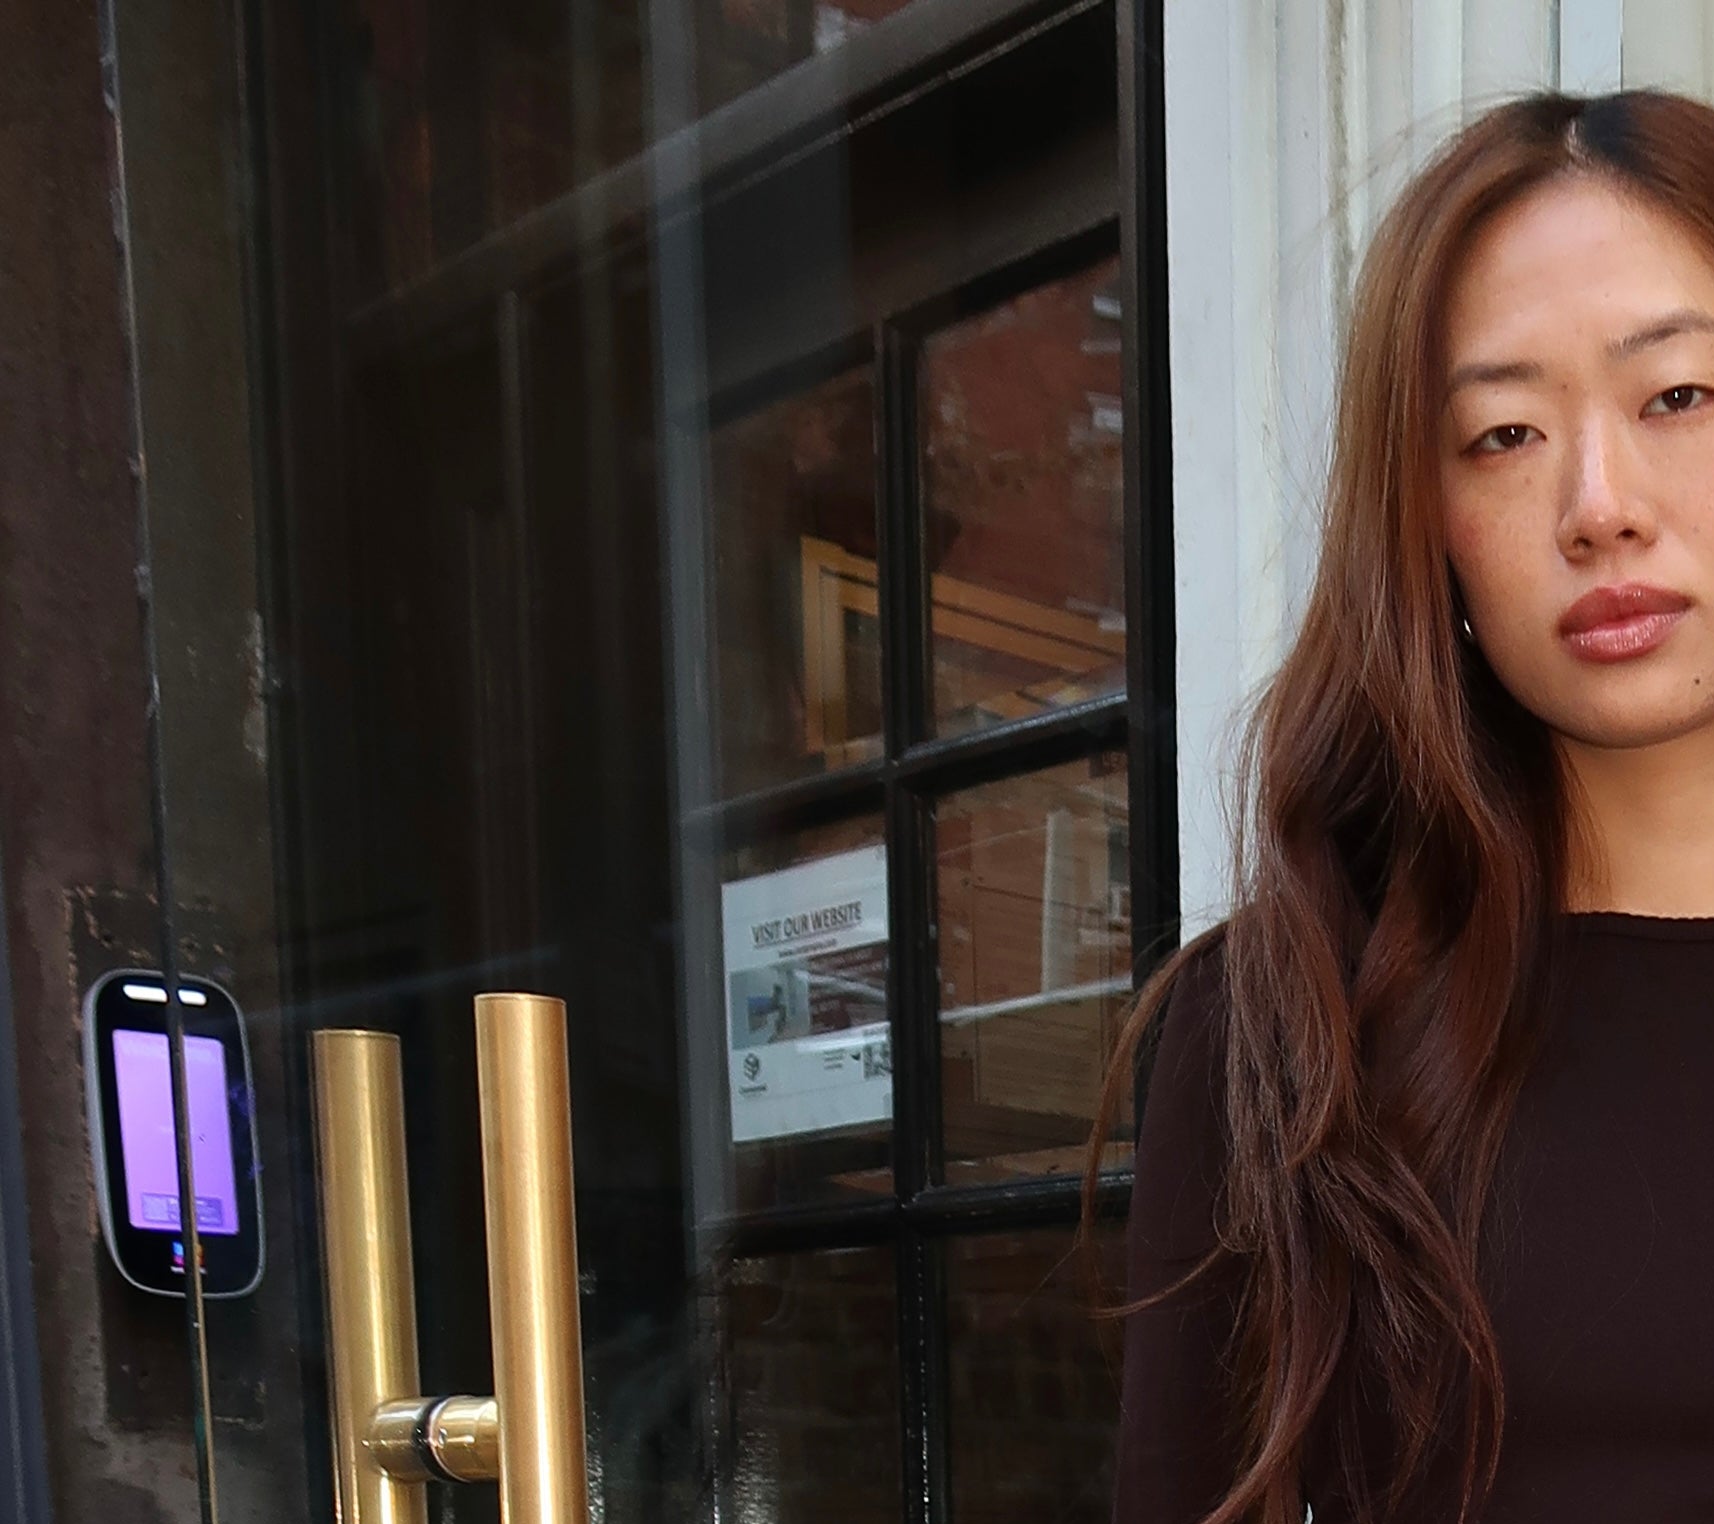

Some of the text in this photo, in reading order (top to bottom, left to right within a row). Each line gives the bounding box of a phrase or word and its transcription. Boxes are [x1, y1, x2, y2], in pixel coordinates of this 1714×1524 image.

[750, 901, 862, 943] VISIT OUR WEBSITE
